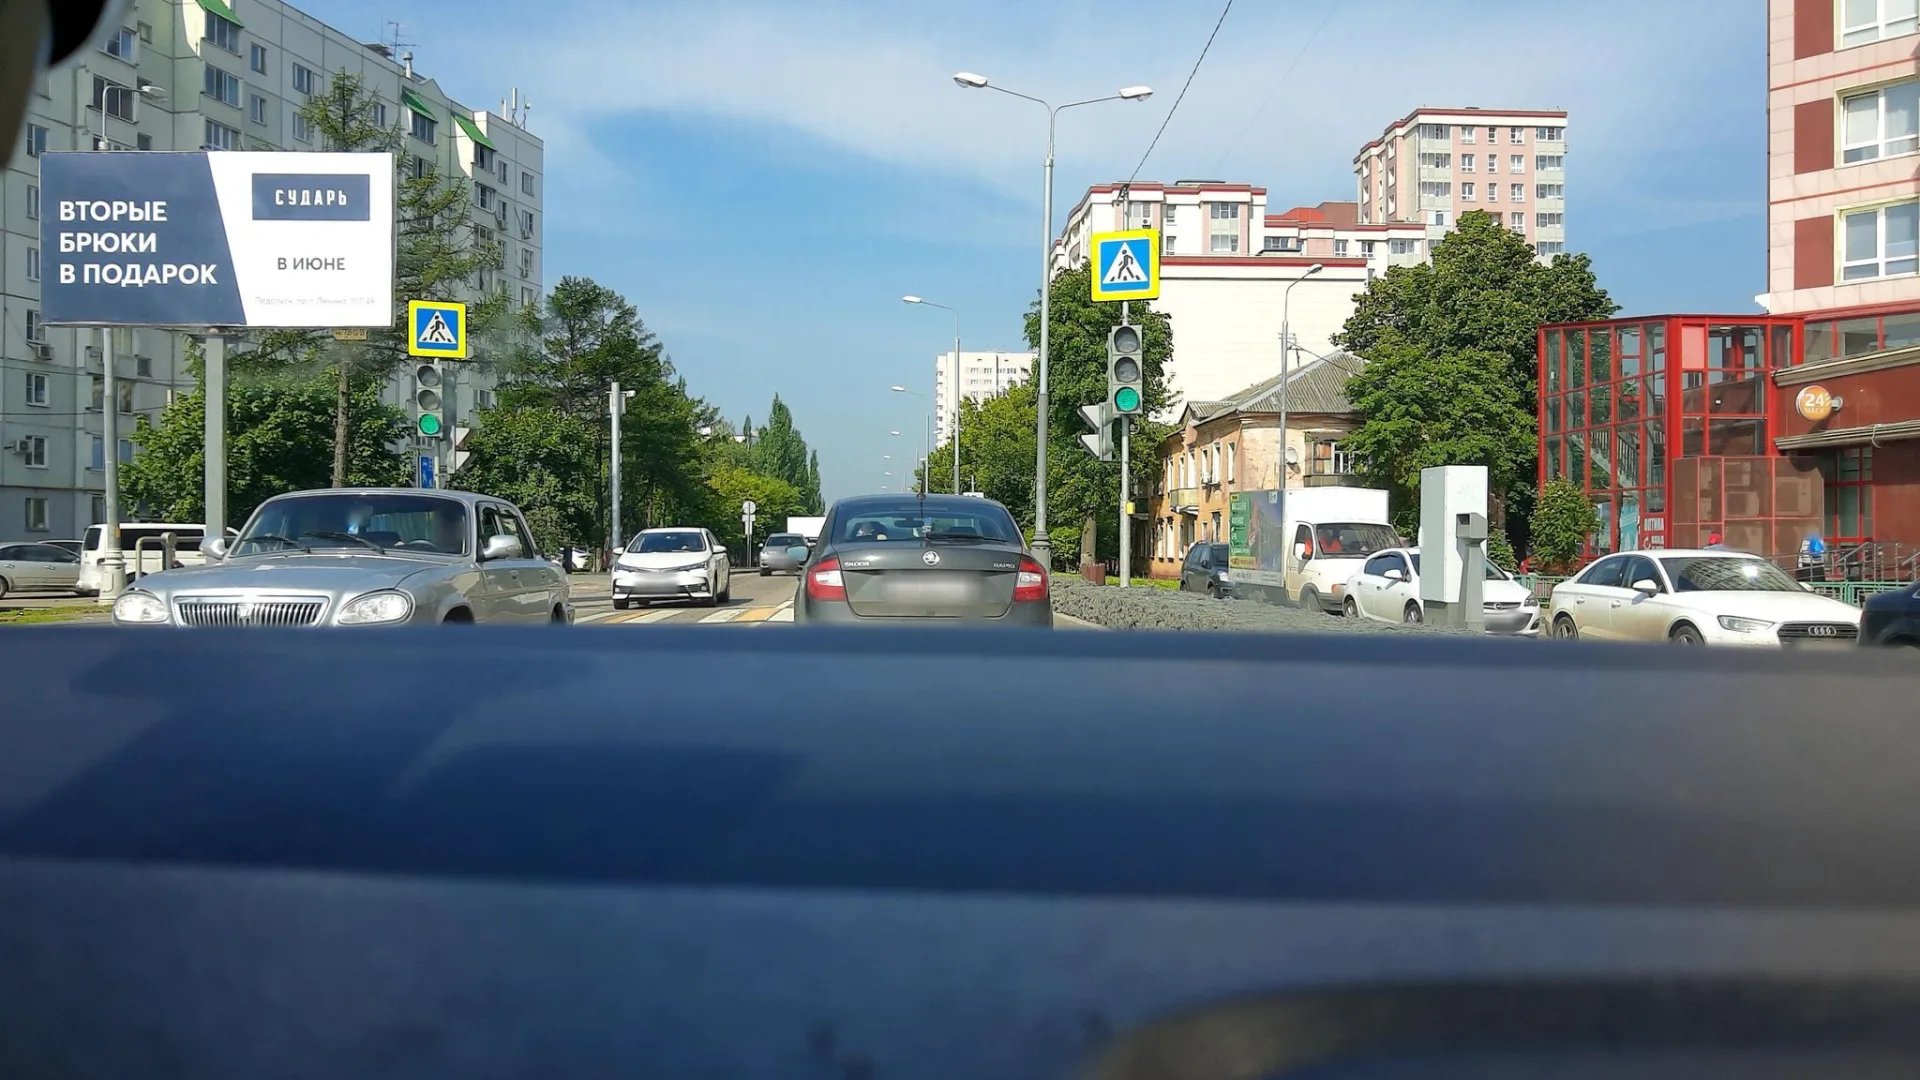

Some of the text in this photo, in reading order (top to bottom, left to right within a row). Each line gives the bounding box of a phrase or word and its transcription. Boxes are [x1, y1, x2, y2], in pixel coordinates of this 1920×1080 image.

[274, 188, 348, 207] СУДАРЬ
[59, 200, 168, 222] ВТОРЫЕ
[59, 232, 157, 253] БРЮКИ
[277, 257, 346, 271] В ИЮНЕ
[59, 263, 218, 288] В ПОДАРОК
[1805, 393, 1824, 407] 24
